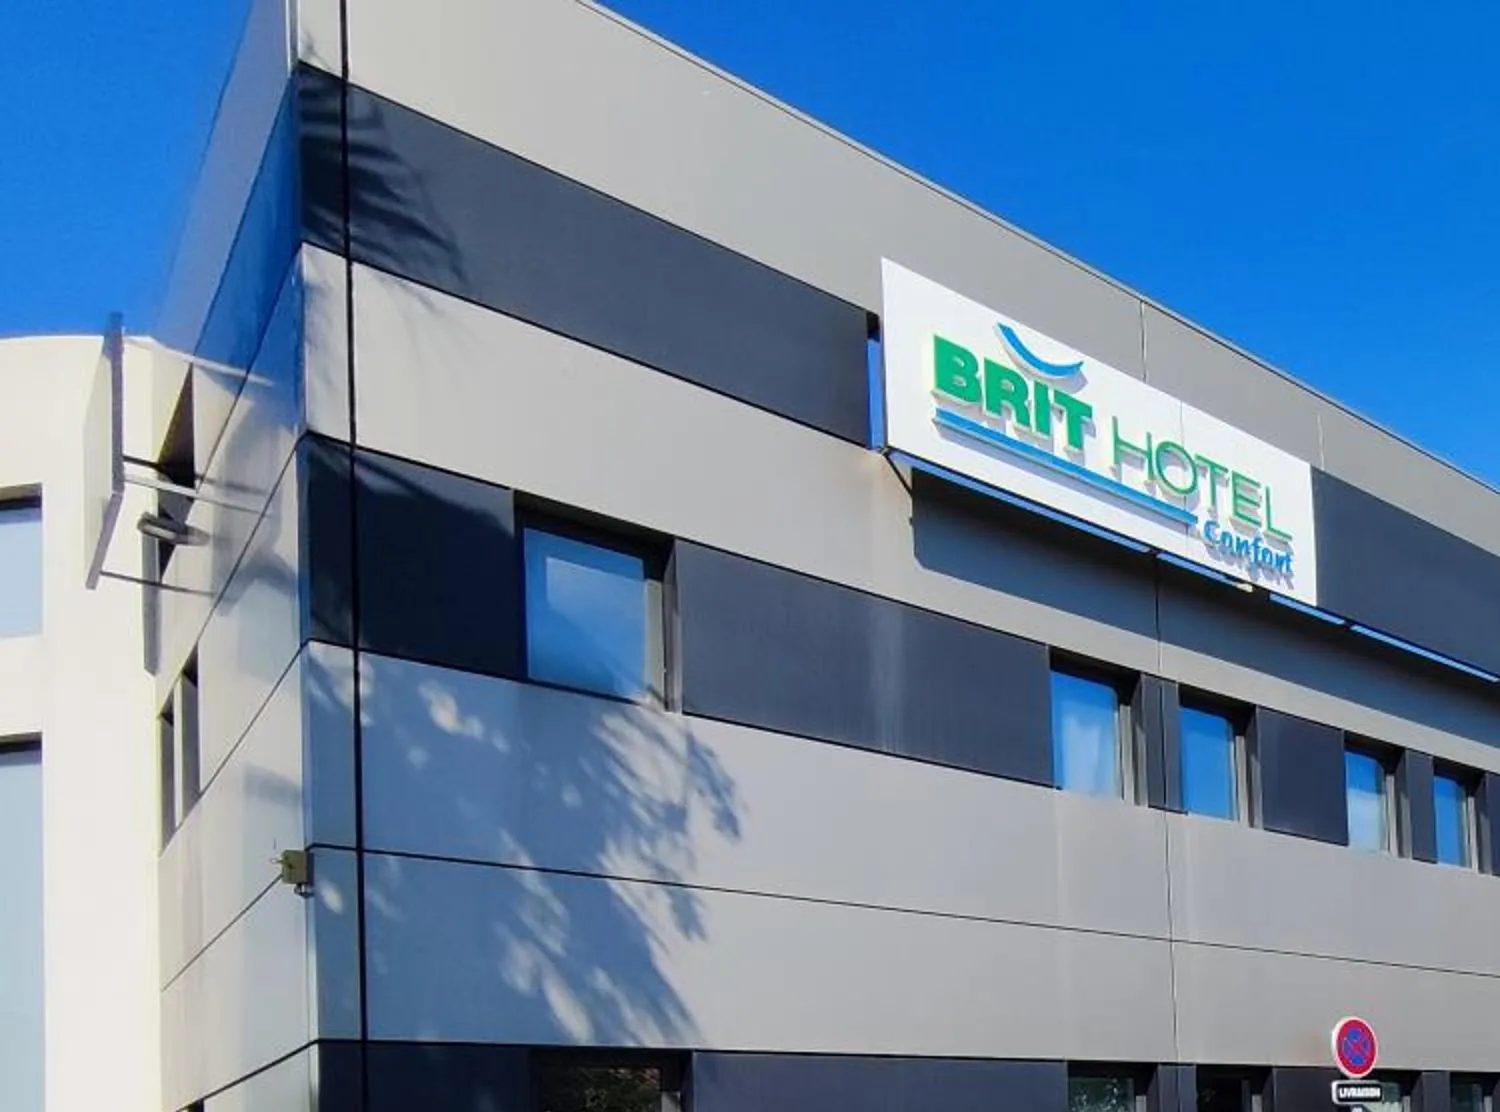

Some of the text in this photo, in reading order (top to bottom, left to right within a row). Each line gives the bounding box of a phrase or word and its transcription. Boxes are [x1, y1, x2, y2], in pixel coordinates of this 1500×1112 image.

[933, 334, 1293, 540] BRIT HOTEL
[1204, 520, 1294, 573] Confort
